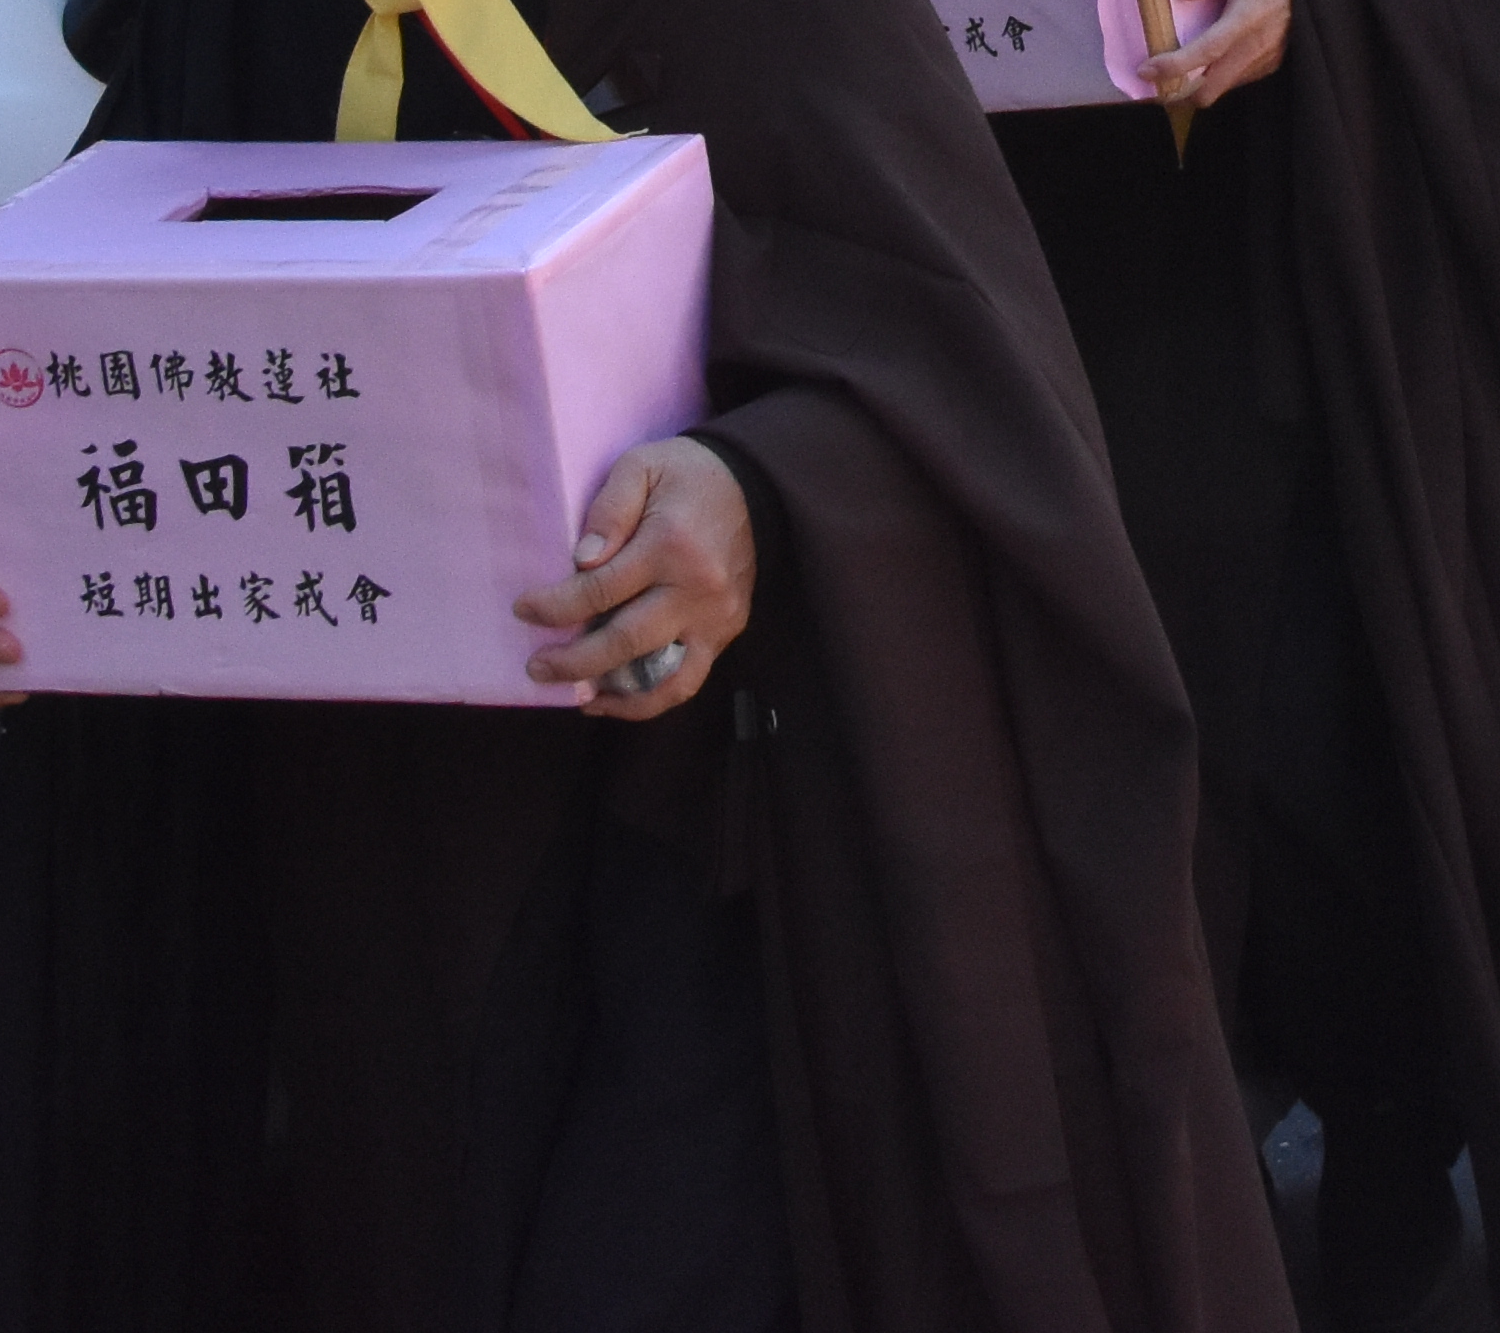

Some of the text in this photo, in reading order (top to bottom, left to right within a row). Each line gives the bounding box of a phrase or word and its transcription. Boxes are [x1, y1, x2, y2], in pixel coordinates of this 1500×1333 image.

[46, 348, 362, 405] 桃園佛教蓮社
[75, 439, 359, 533] 福田箱
[78, 570, 393, 626] 短期出家戒會
